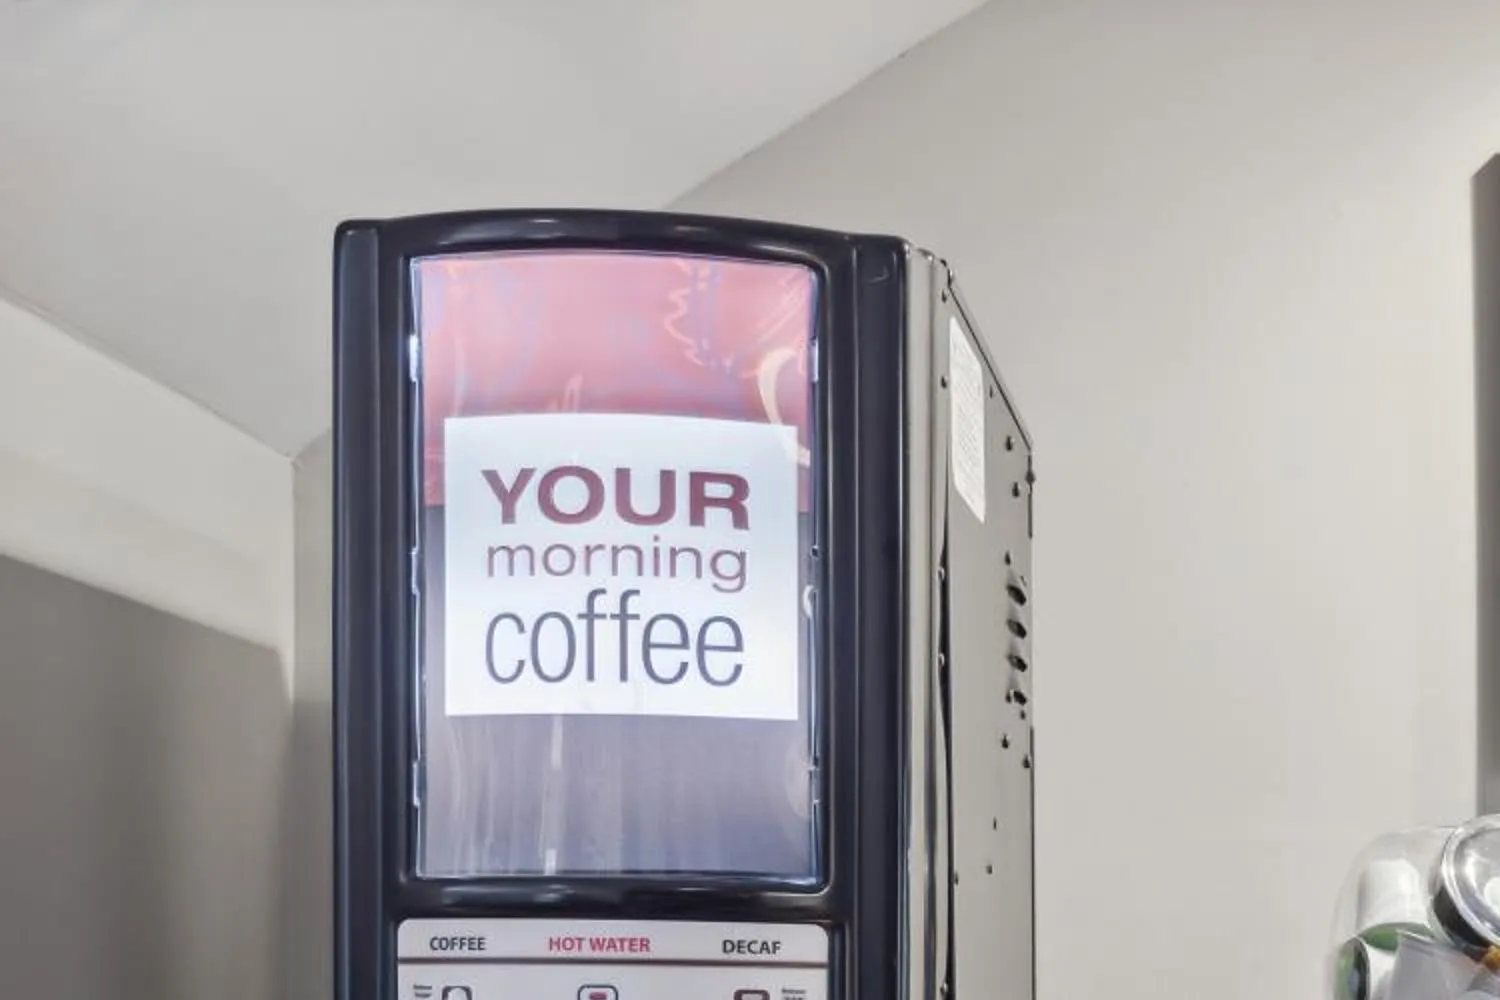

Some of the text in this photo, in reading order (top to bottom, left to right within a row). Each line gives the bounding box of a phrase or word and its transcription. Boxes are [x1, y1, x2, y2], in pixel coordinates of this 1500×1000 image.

[480, 465, 751, 531] YOUR
[486, 534, 748, 594] morning
[485, 588, 745, 687] coffee
[429, 936, 487, 951] COFFEE
[549, 937, 652, 953] HOT WATER
[722, 939, 782, 955] DECAF
